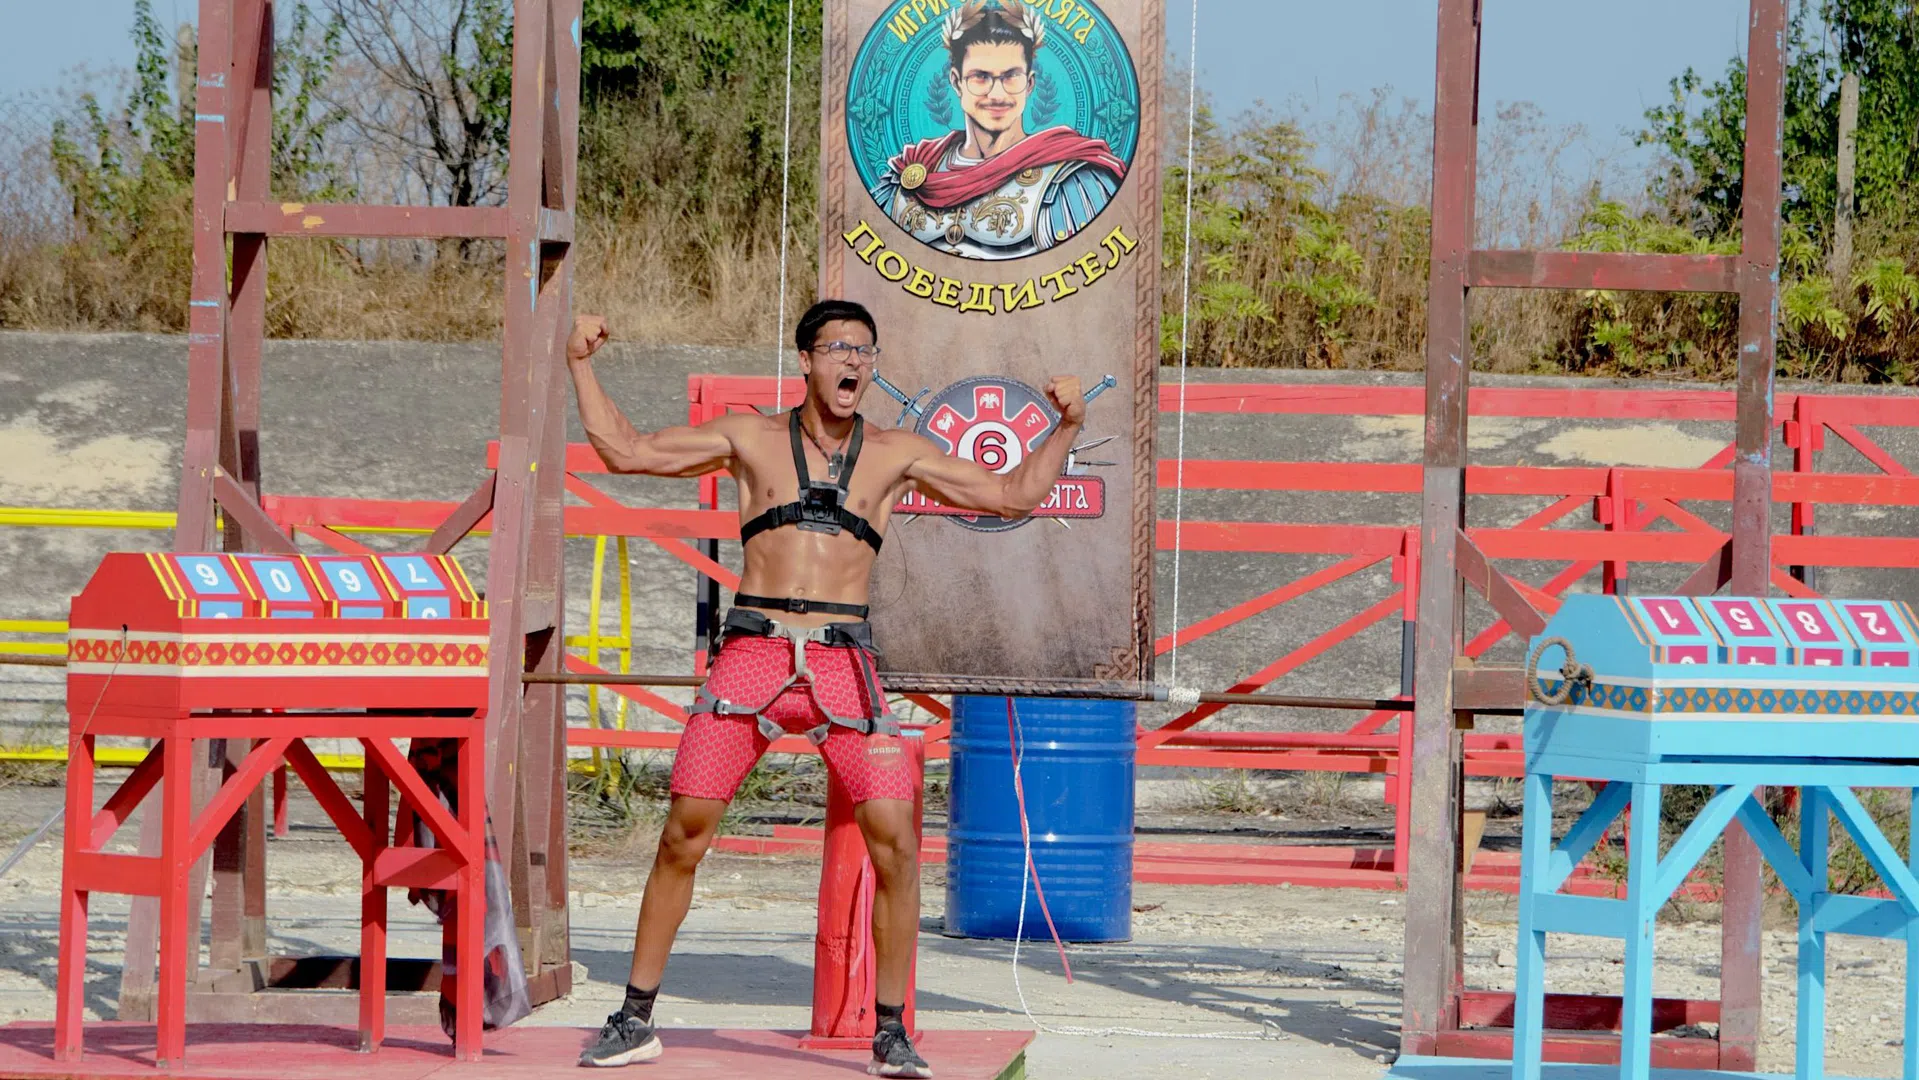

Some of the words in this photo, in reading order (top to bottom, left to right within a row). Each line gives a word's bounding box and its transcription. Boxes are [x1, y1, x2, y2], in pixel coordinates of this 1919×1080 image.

[842, 219, 1139, 315] ПОБЕДИТЕЛ
[973, 430, 1008, 471] 6
[1040, 484, 1089, 509] ЯТА
[269, 568, 292, 593] 0
[1657, 606, 1680, 630] 1
[1728, 607, 1755, 631] 5
[1795, 610, 1822, 635] 8
[1859, 611, 1887, 636] 2
